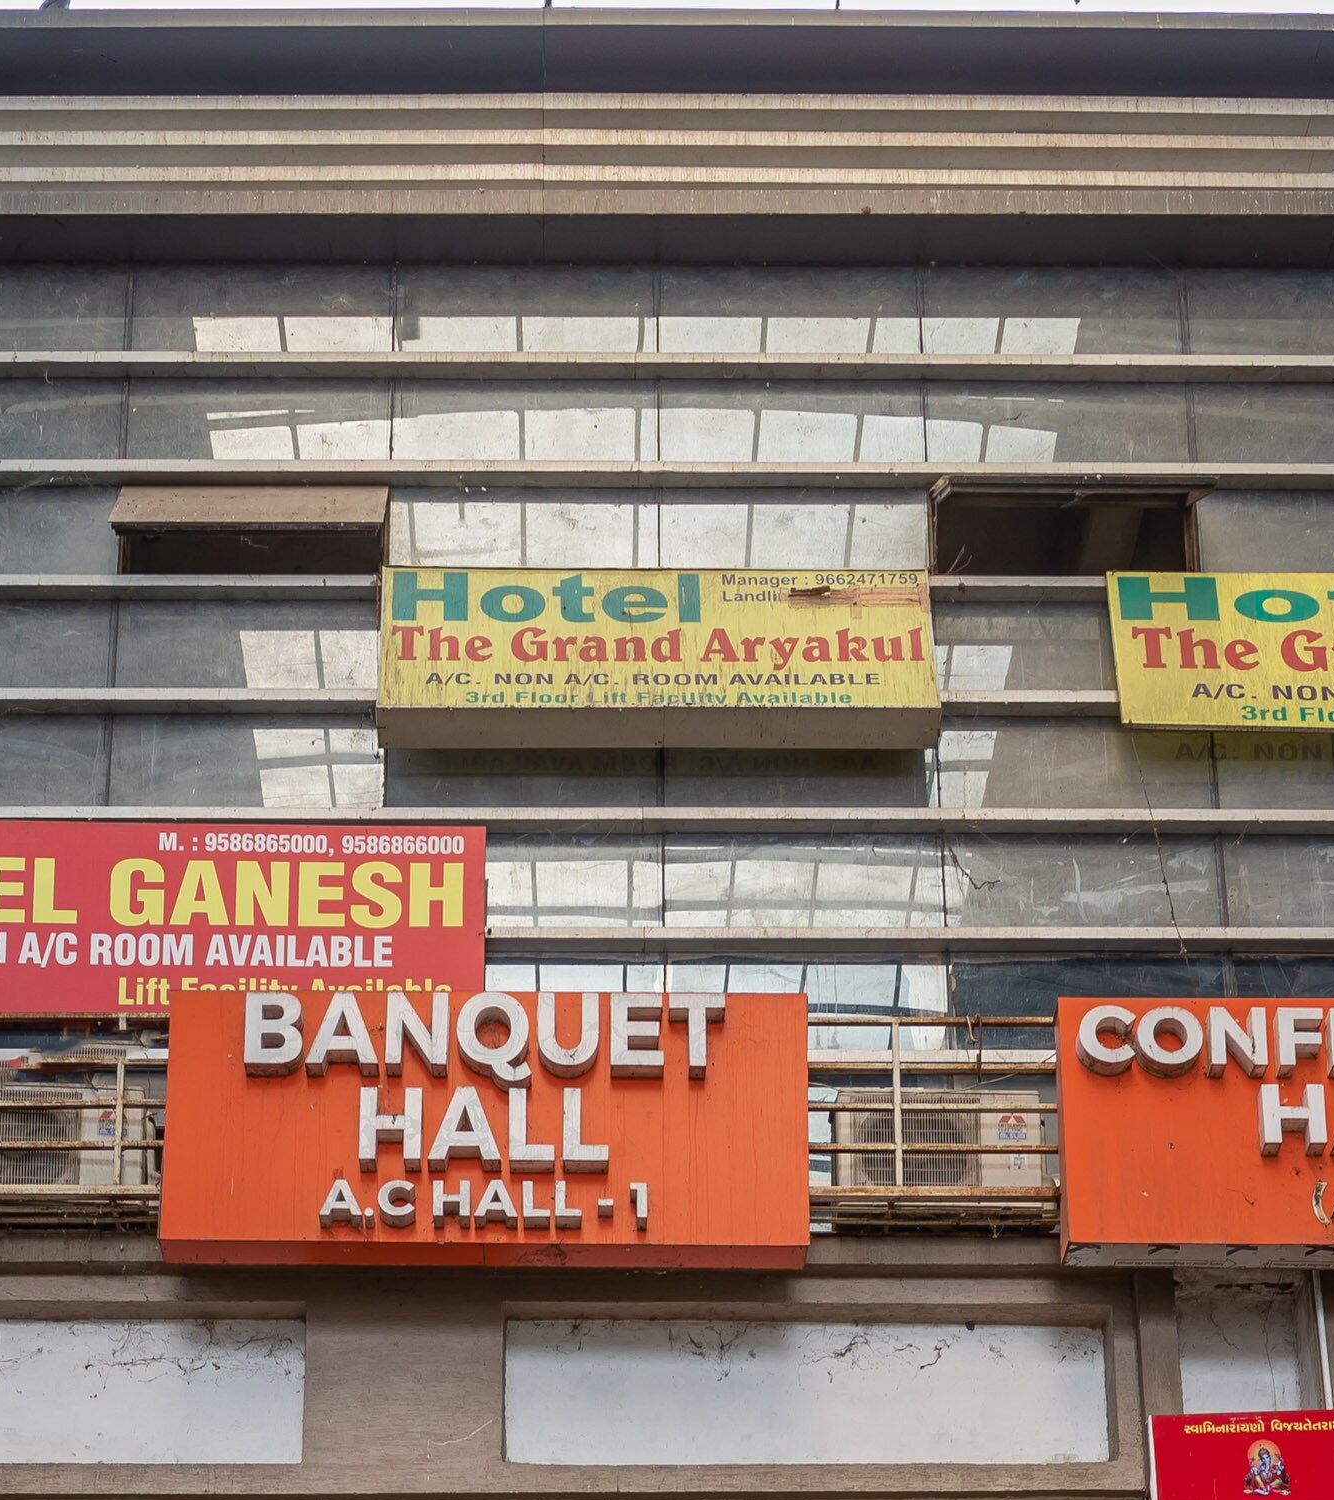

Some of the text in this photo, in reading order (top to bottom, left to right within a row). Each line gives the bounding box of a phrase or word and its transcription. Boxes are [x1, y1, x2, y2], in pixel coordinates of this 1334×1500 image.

[721, 572, 919, 588] Manager 9662471759
[722, 590, 778, 603] Landli
[391, 571, 701, 624] Hotel
[391, 625, 925, 671] The Grand Aryakul
[1132, 626, 1259, 671] The
[425, 672, 881, 687] A/C. NON A/C. ROOM AVAILABLE
[1190, 683, 1258, 702] A/C.
[465, 690, 853, 707] 3rd Floor Lift Facility Available
[1240, 705, 1288, 723] 3rd
[158, 832, 465, 857] M. 9586865000, 9586866000
[110, 858, 465, 928] GANESH
[18, 931, 78, 968] A/C
[90, 933, 194, 967] ROOM
[204, 934, 394, 968] AVAILABLE
[118, 976, 170, 1006] Lift
[243, 991, 726, 1089] BANQUET
[358, 1086, 610, 1174] HALL
[319, 1178, 649, 1232] A.C HALL 1
